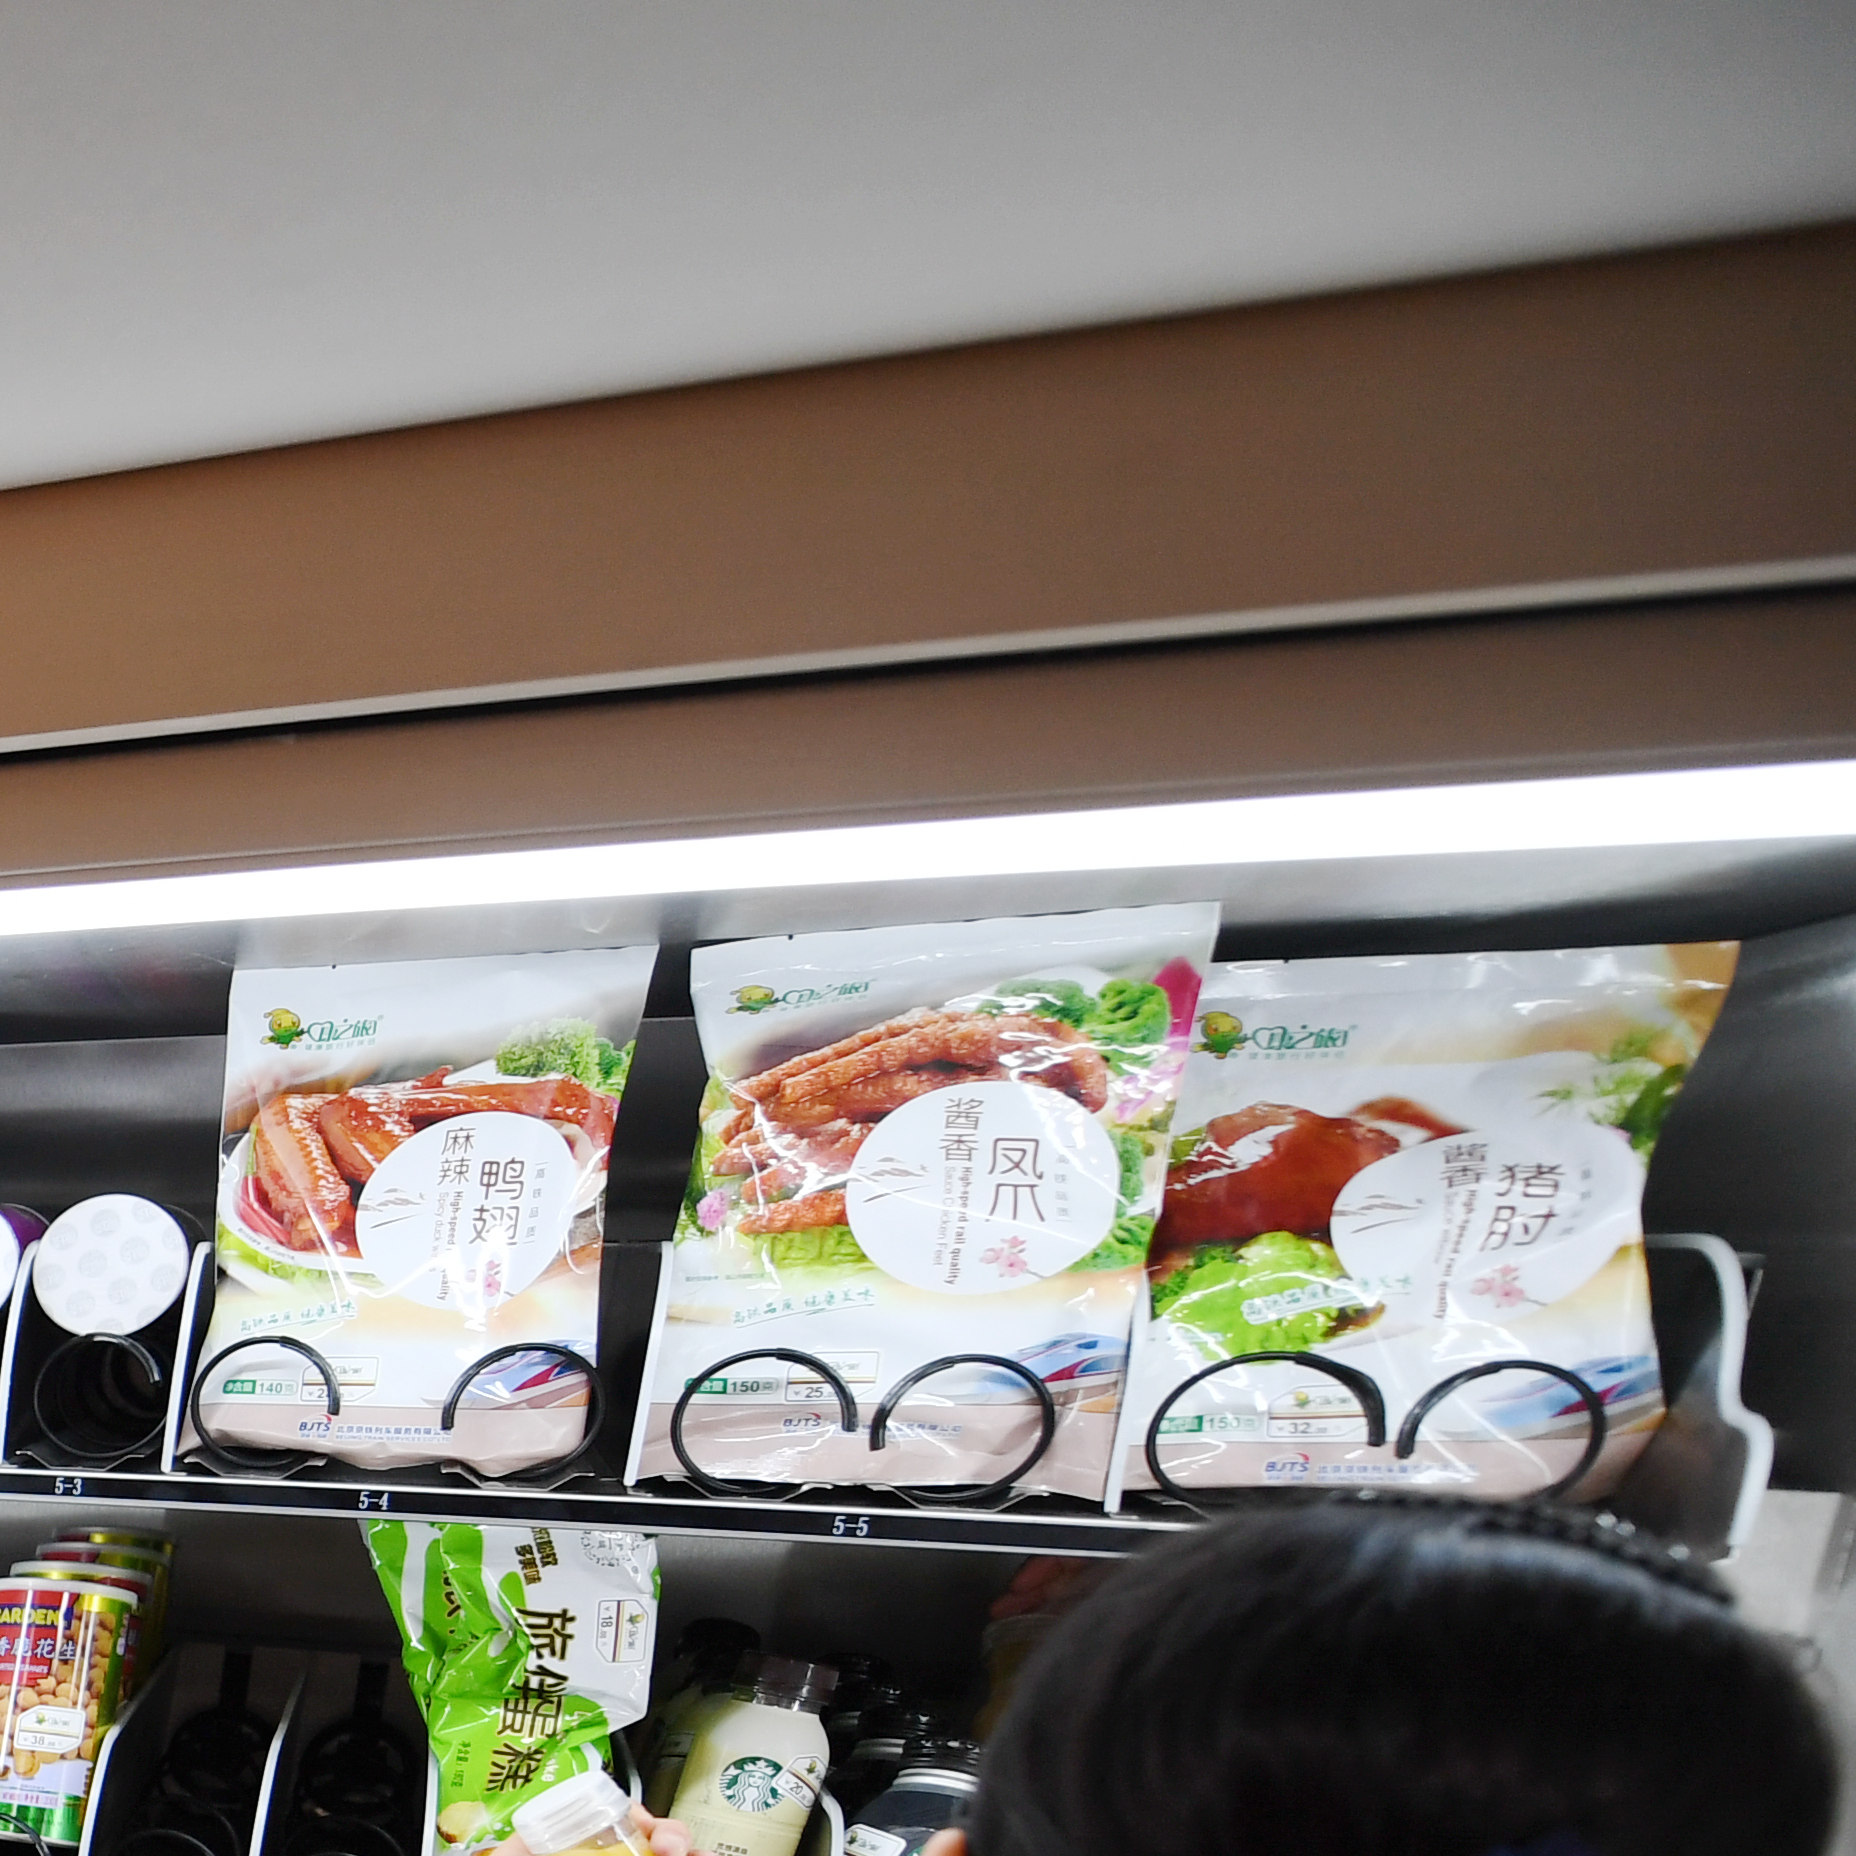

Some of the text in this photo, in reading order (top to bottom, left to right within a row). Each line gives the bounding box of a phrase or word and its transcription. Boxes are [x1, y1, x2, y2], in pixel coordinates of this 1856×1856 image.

[939, 1097, 984, 1162] 酱香
[438, 1126, 476, 1186] 麻辣
[1440, 1142, 1488, 1188] 酱香
[985, 1137, 1046, 1222] 凤爪
[468, 1157, 525, 1246] 鸭翅
[1479, 1163, 1566, 1252] 猪肘
[299, 1422, 331, 1433] BJTS
[782, 1417, 822, 1428] BJTS
[1265, 1461, 1310, 1473] BJTS
[54, 1477, 82, 1496] 5-3
[358, 1492, 389, 1511] 5-4
[832, 1516, 870, 1537] 5-5
